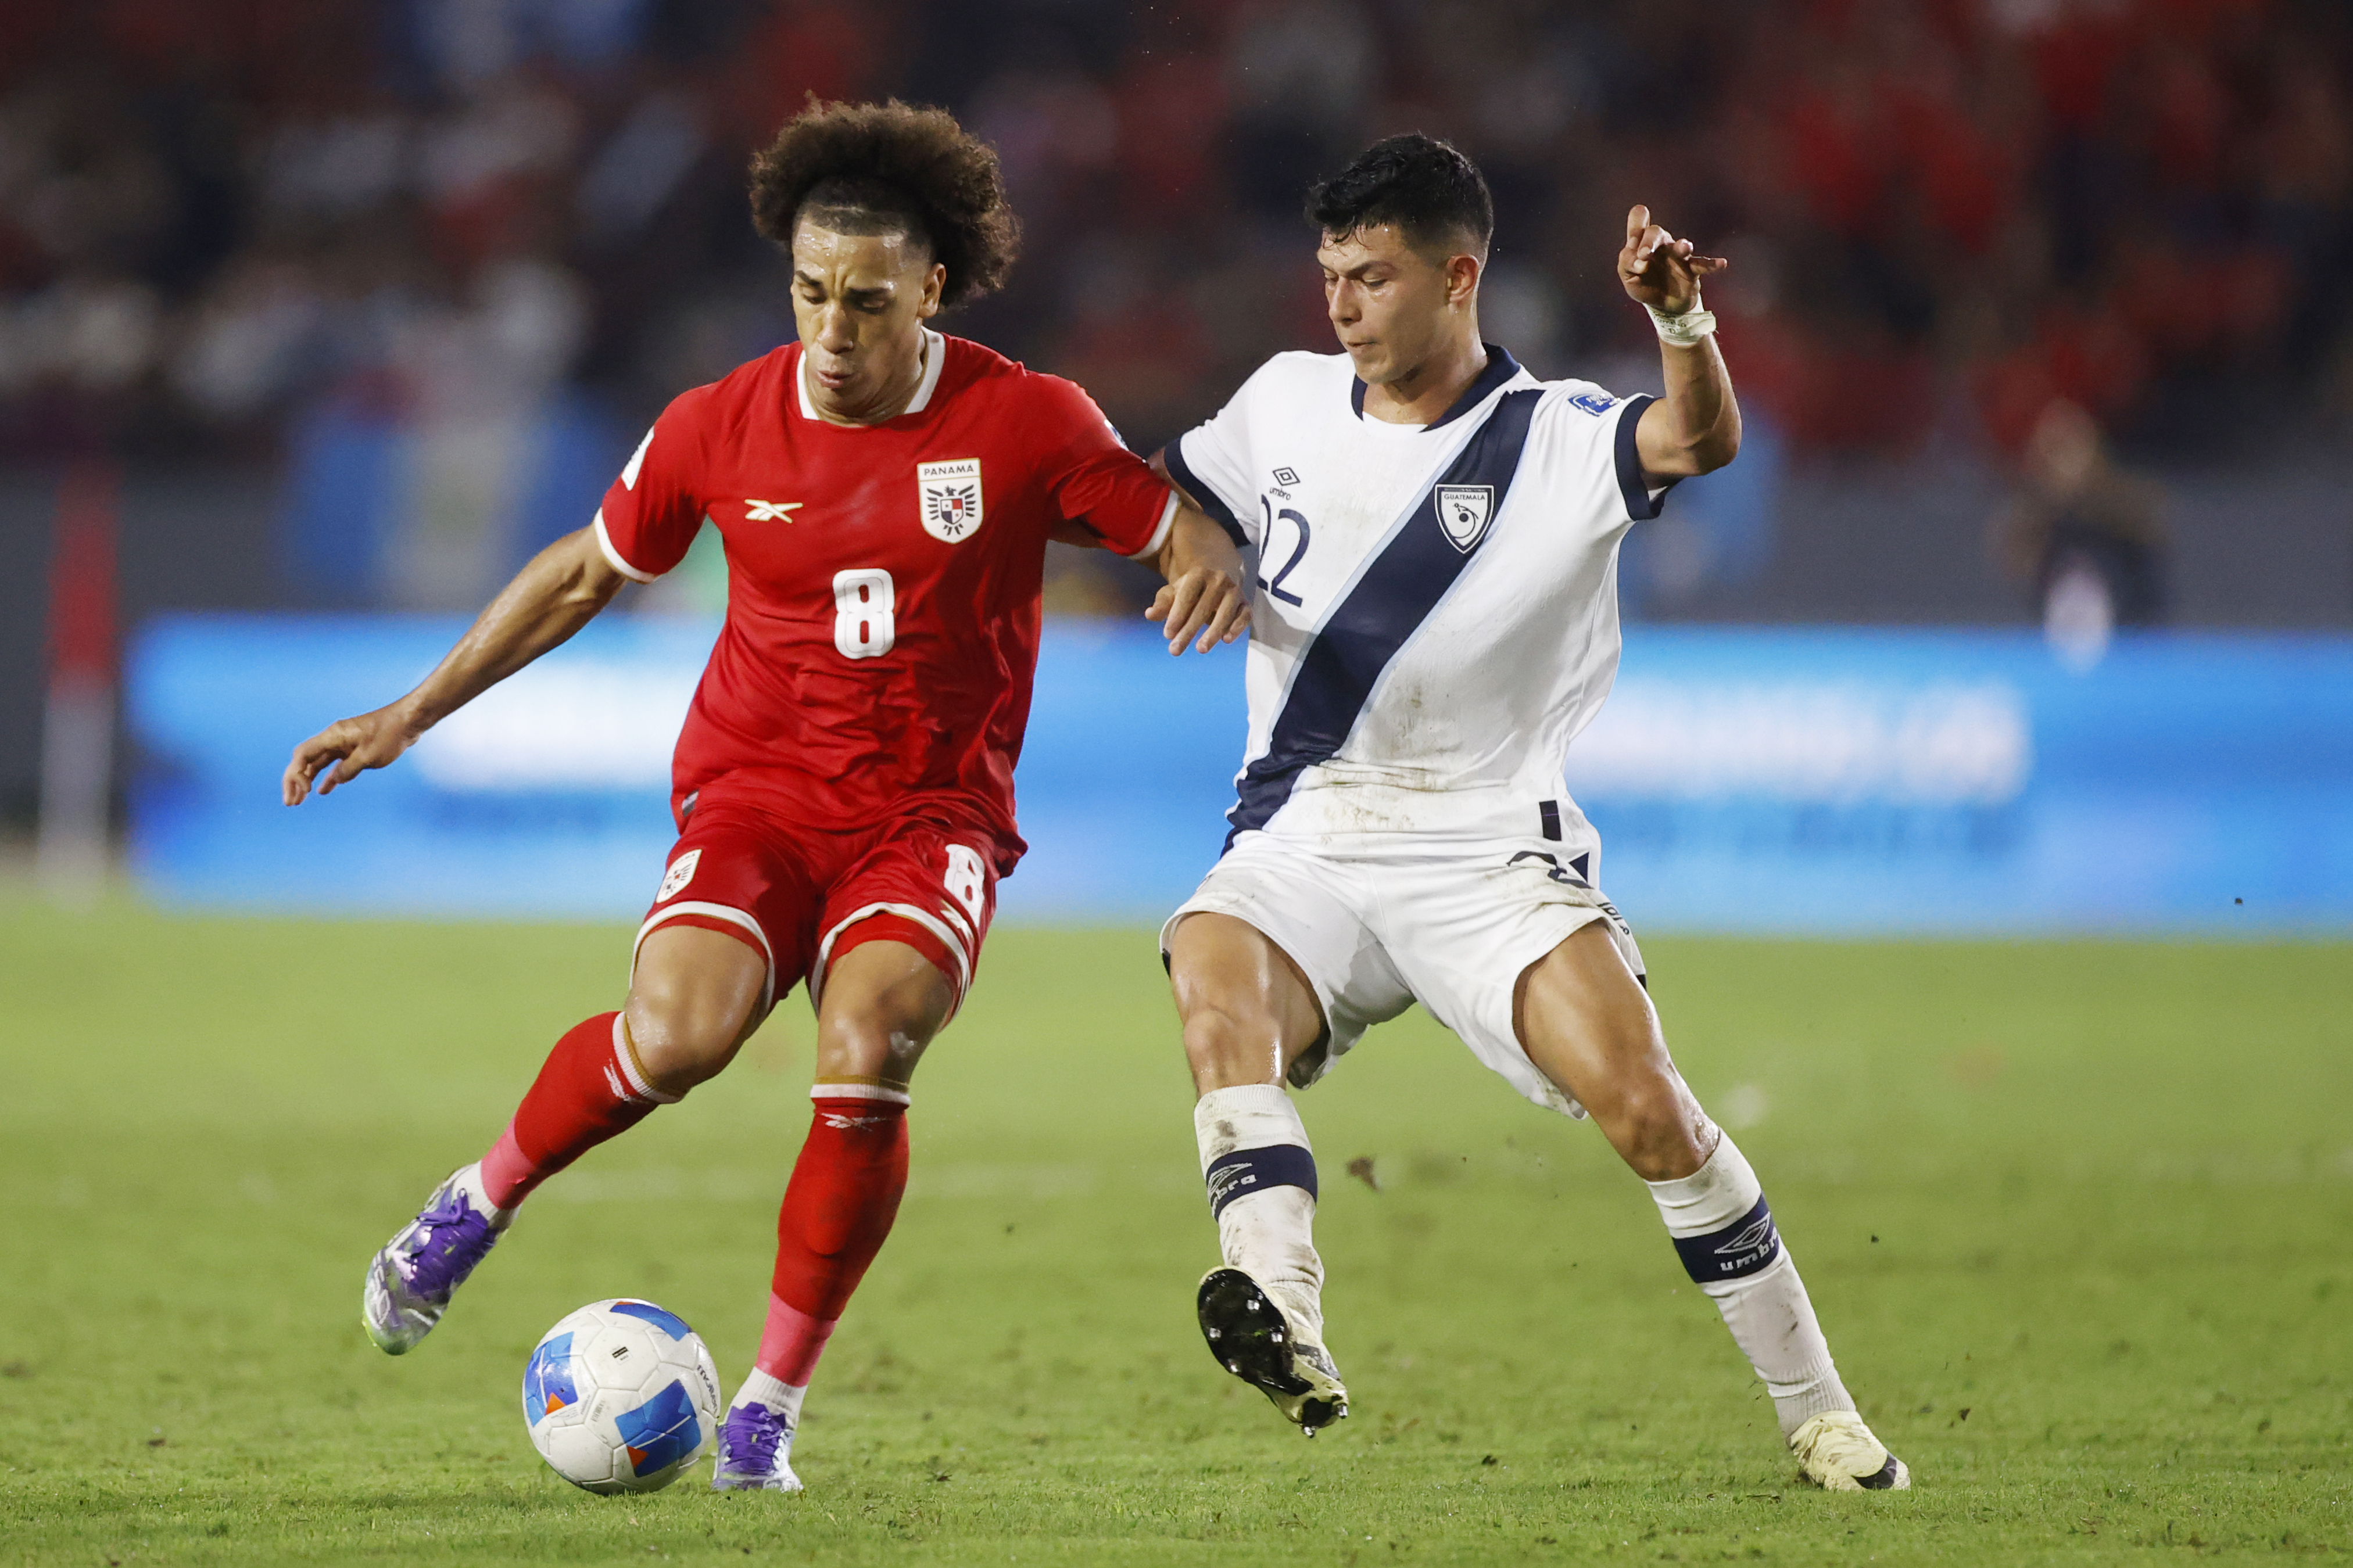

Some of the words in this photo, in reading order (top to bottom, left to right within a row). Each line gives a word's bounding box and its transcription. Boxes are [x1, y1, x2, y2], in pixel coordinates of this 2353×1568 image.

[924, 463, 974, 476] PANAMÁ
[1269, 487, 1291, 501] umbro
[833, 568, 895, 659] 8
[944, 844, 985, 929] 8
